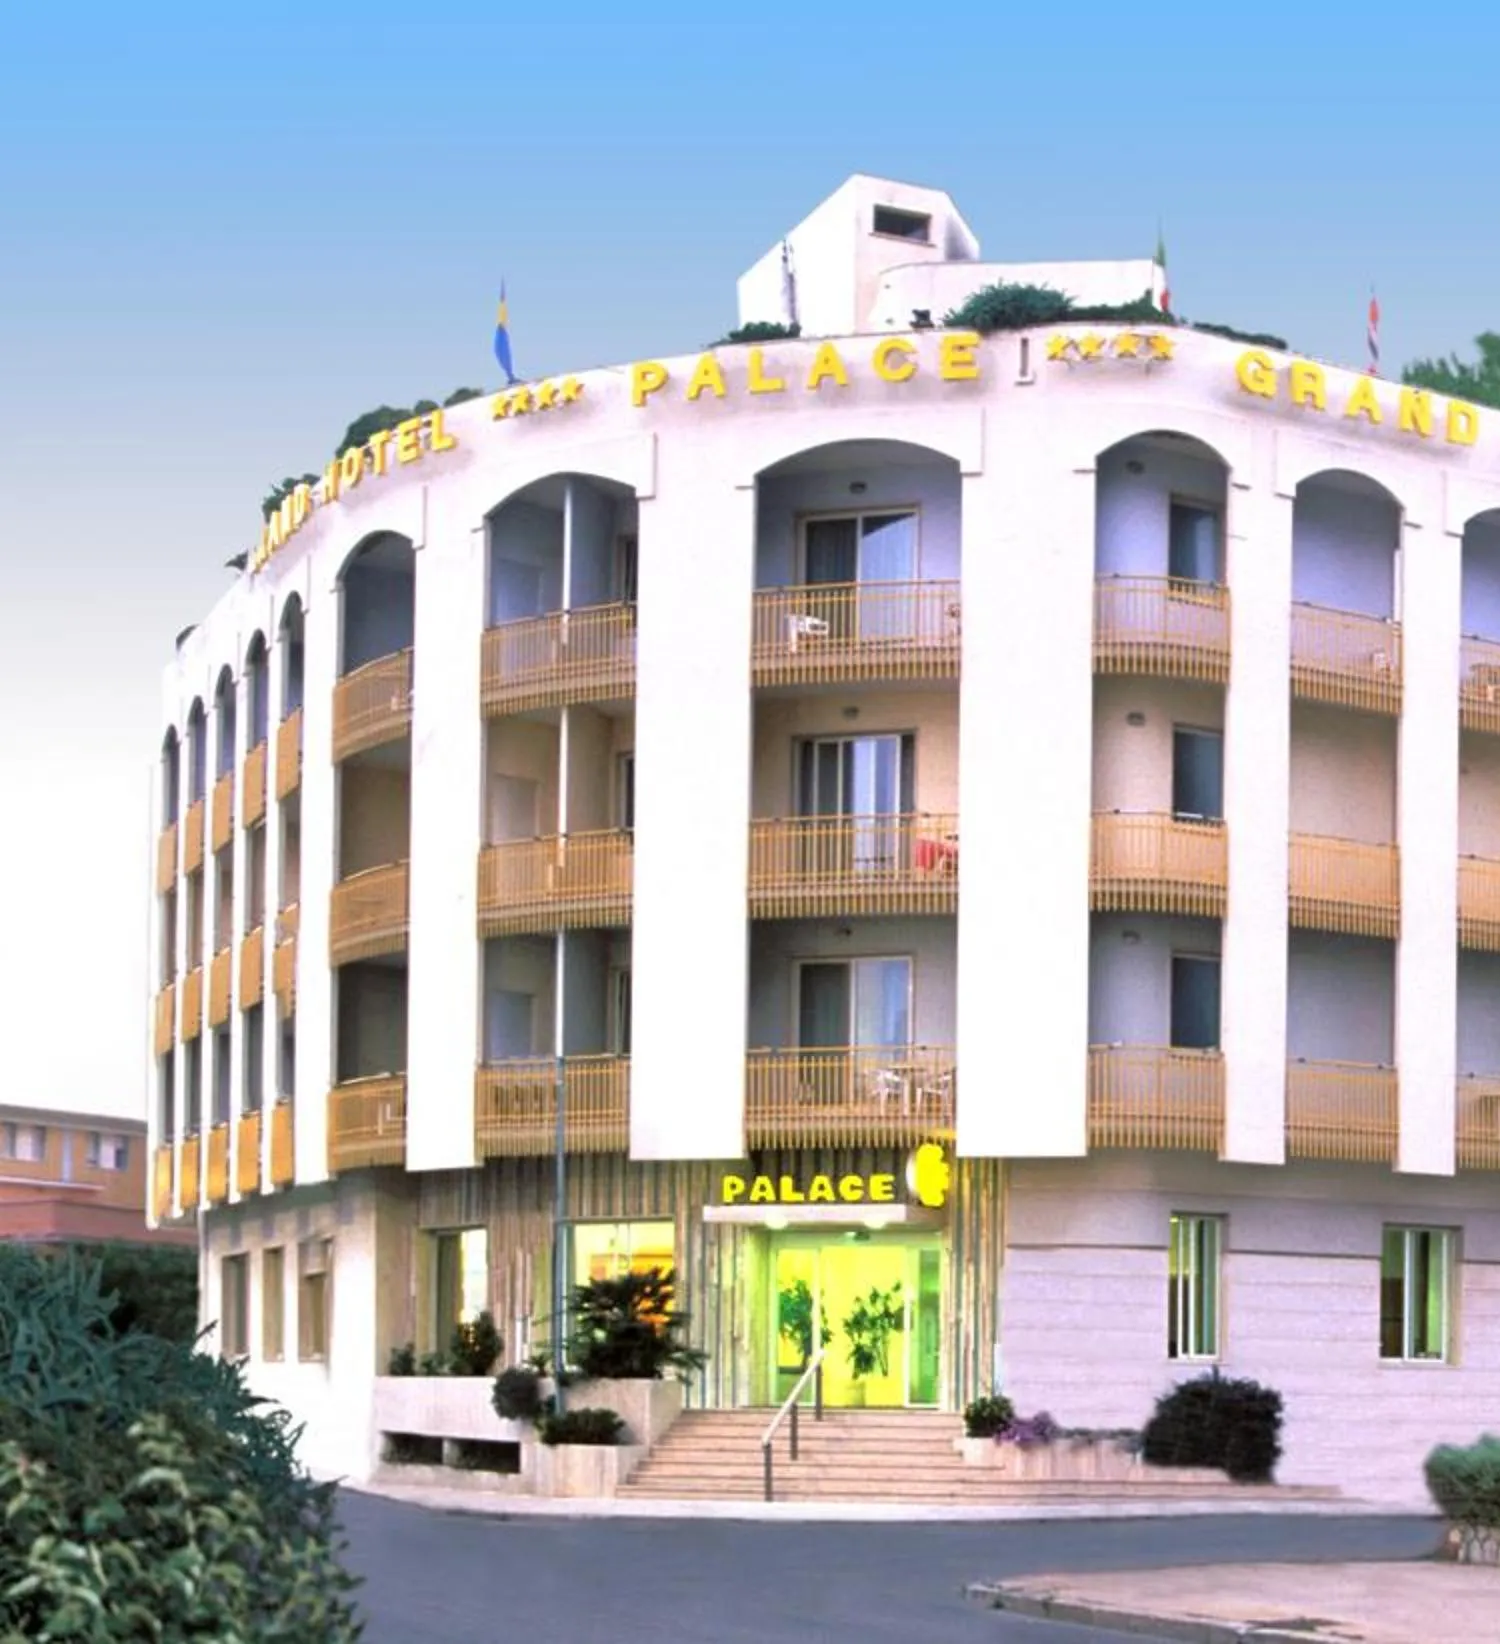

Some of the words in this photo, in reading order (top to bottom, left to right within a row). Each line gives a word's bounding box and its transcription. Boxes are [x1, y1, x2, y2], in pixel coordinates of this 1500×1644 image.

[632, 331, 981, 406] PALACE
[1234, 350, 1480, 446] GRAND
[322, 409, 458, 504] HOTEL
[722, 1174, 895, 1202] PALACE
